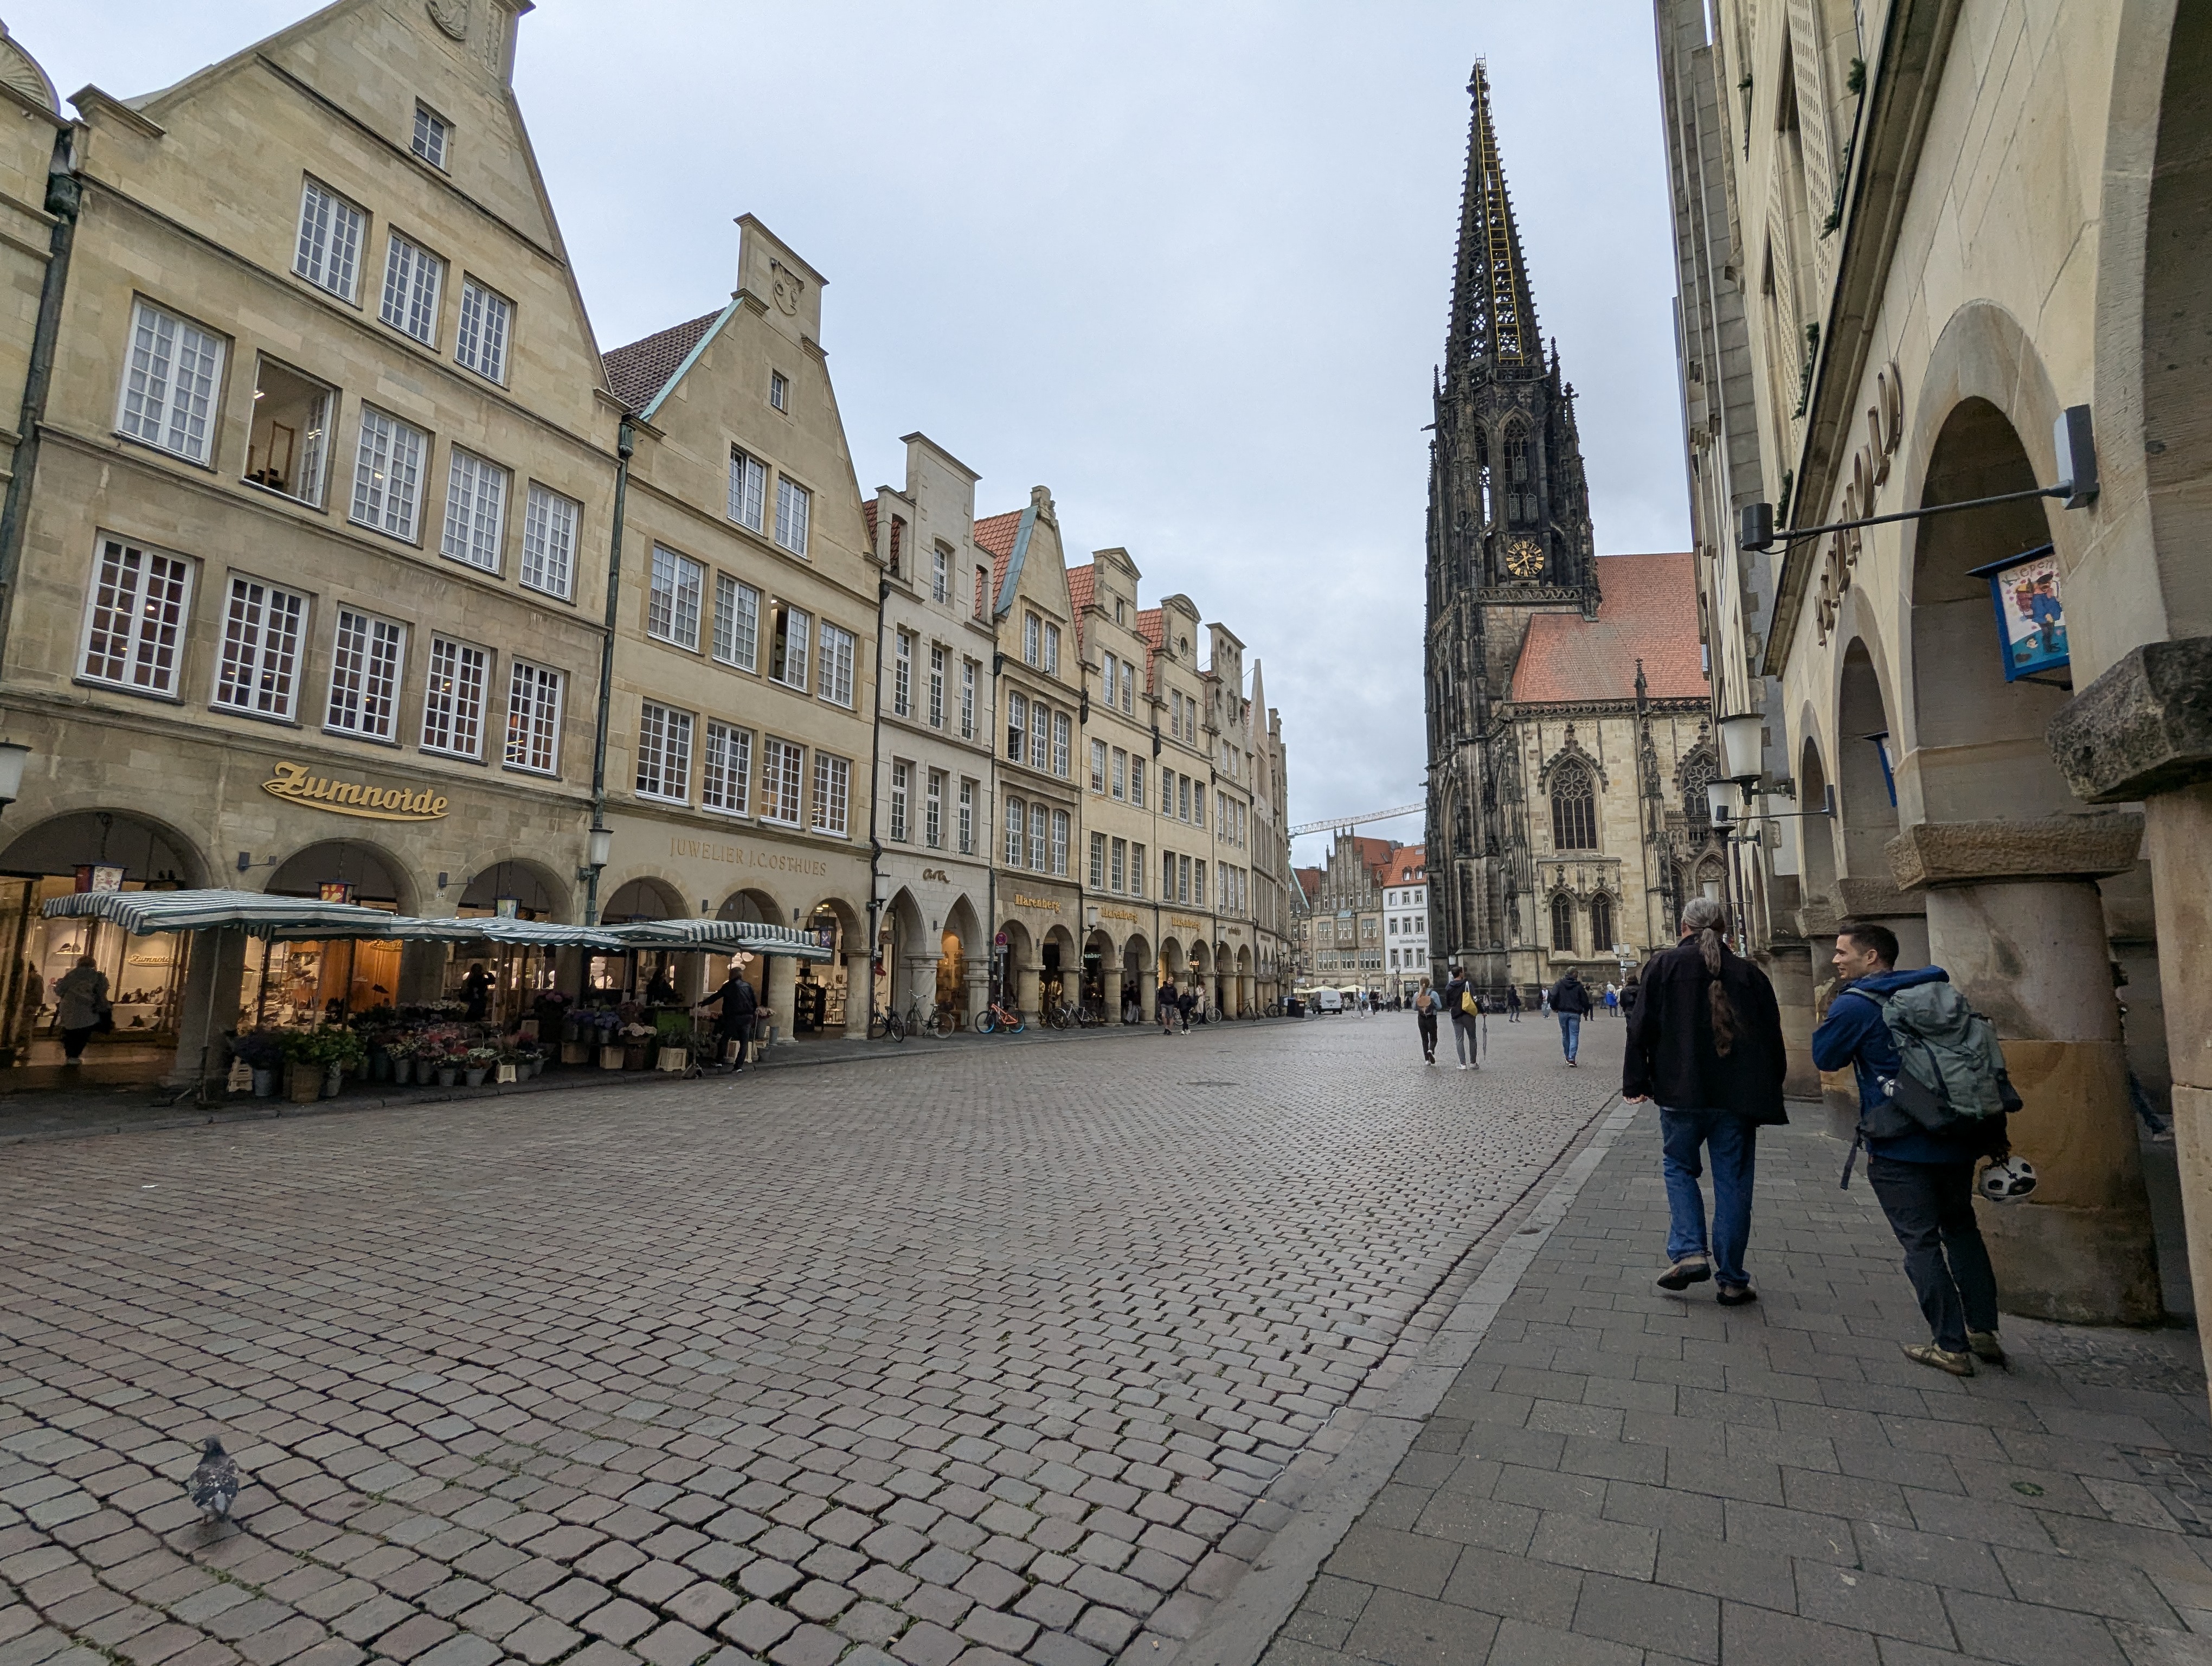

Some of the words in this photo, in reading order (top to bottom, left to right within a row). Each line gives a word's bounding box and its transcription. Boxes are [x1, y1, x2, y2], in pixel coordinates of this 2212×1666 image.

[261, 761, 449, 820] Zumnorde
[670, 837, 744, 864] JUWELIER
[923, 868, 950, 883] ara
[1015, 894, 1061, 914] Harenberg
[1101, 907, 1138, 924] Harenberg
[1172, 917, 1201, 932] Harenberg
